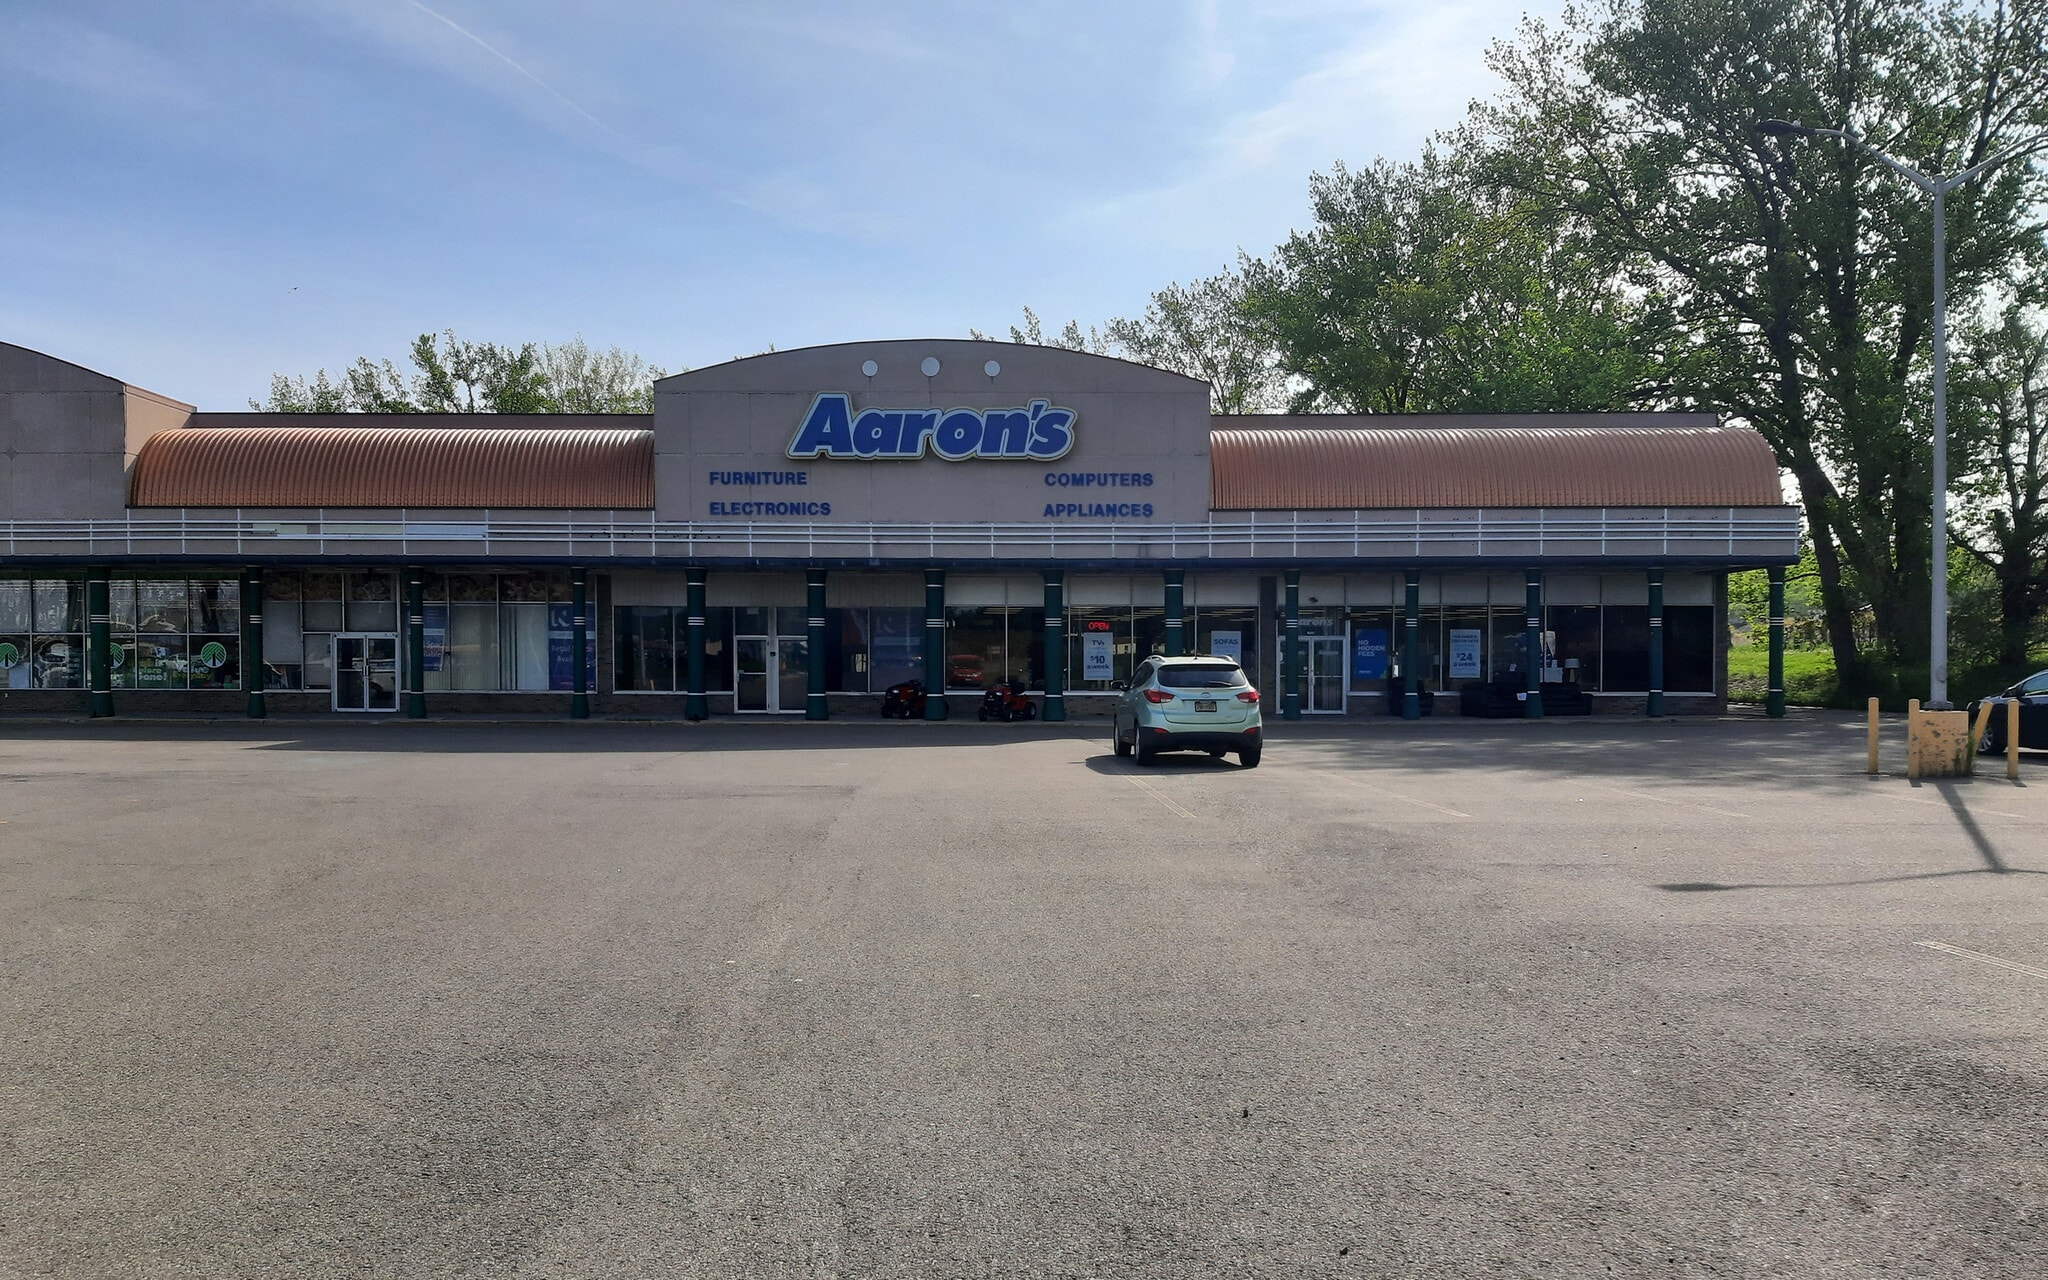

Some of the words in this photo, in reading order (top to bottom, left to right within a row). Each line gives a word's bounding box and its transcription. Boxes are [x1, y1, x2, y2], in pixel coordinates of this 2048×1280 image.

[788, 393, 1074, 460] Aaron's
[709, 471, 808, 486] FURNITURE
[1044, 472, 1154, 487] COMPUTERS
[709, 502, 831, 516] ELECTRONICS
[1043, 503, 1154, 517] APPLIANCES
[1088, 621, 1111, 631] OPEN
[1091, 655, 1105, 664] $10
[1456, 652, 1473, 661] $24
